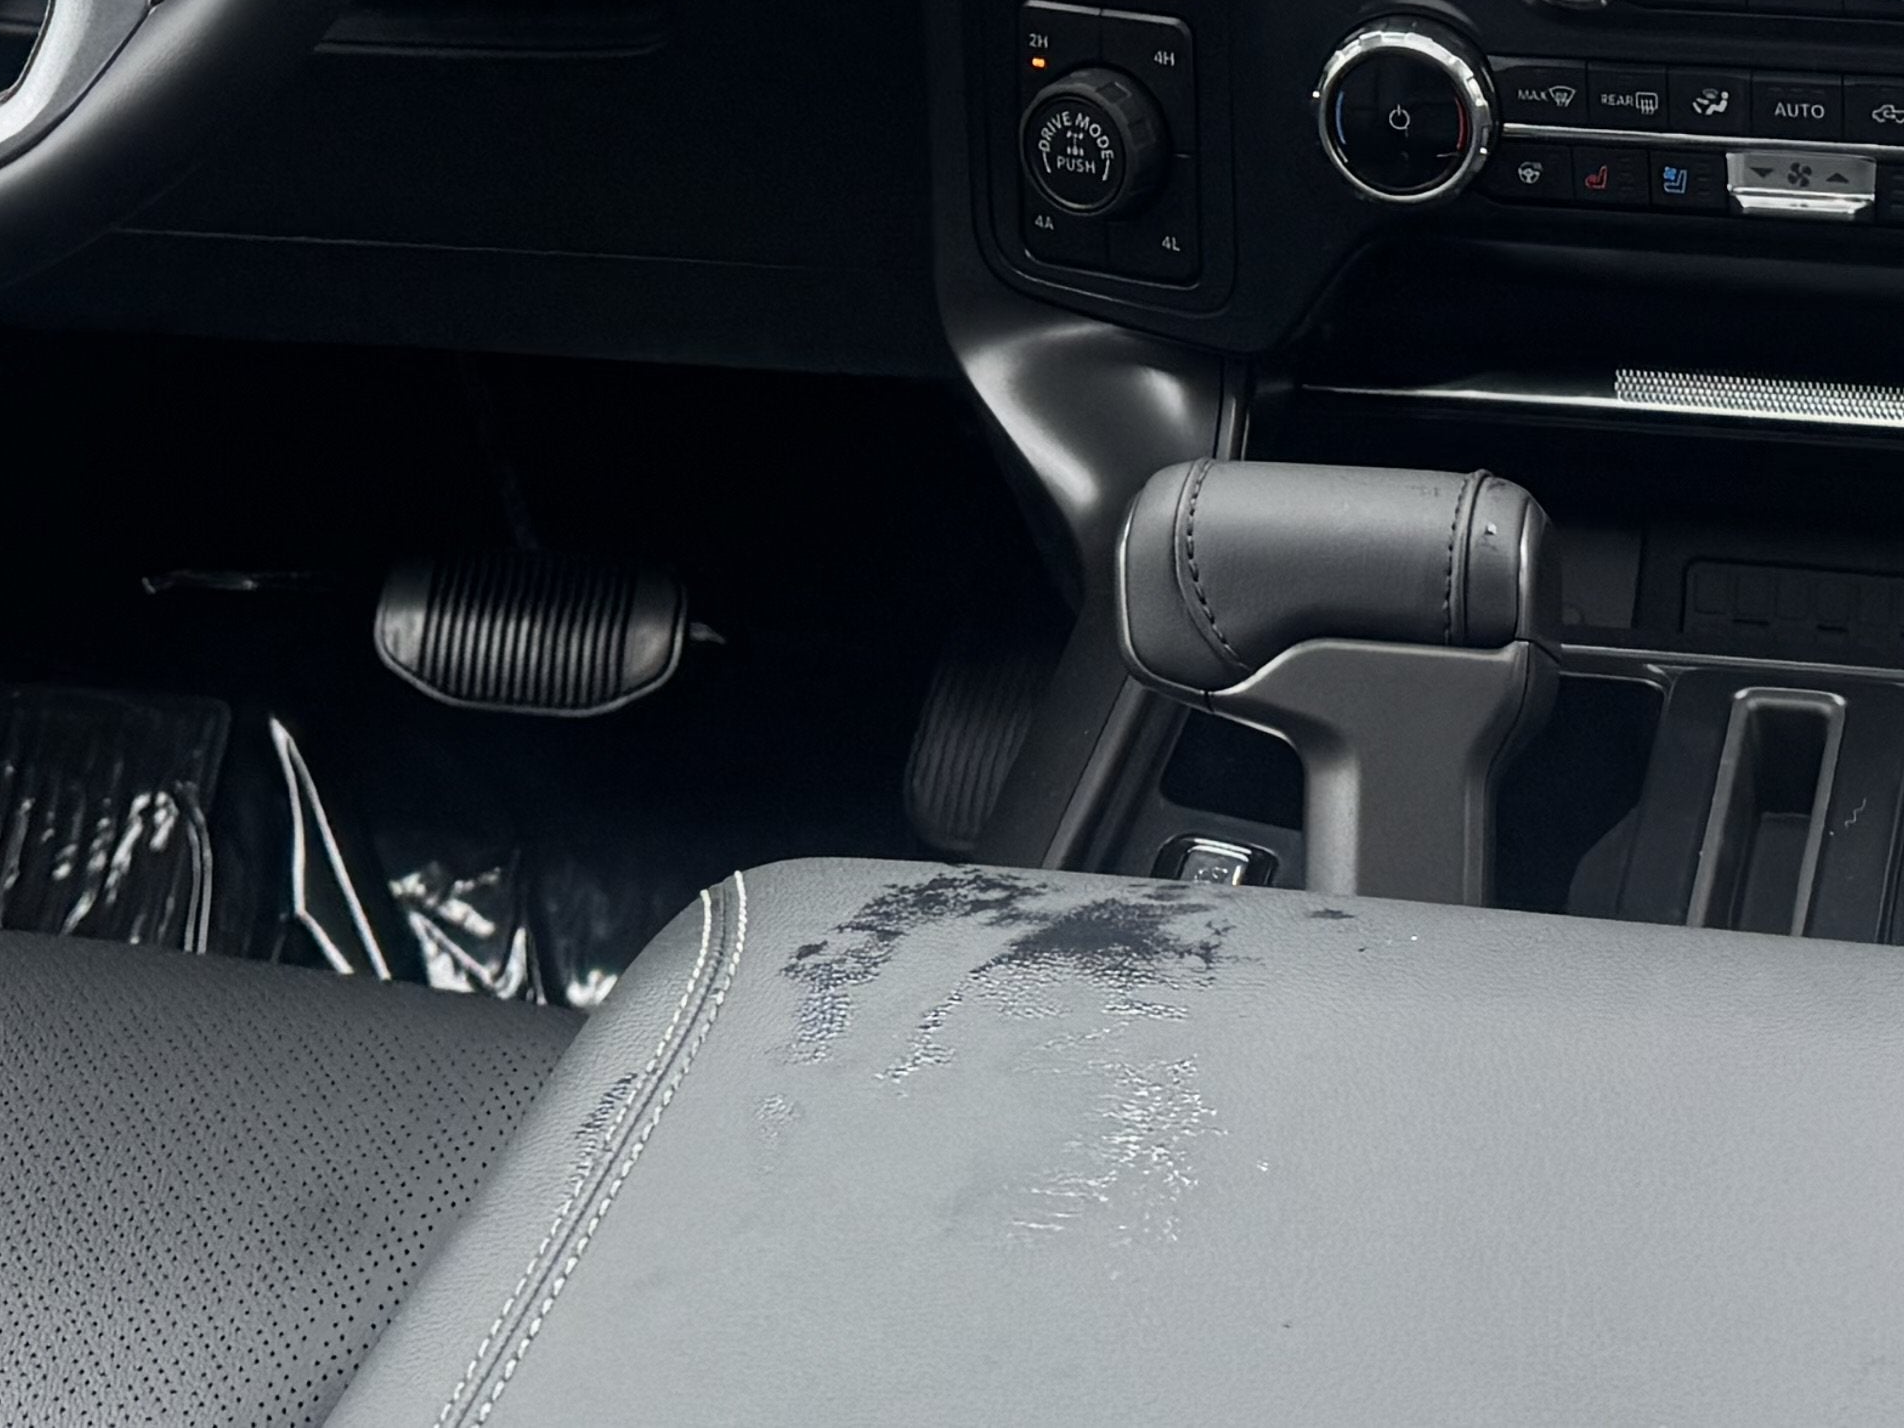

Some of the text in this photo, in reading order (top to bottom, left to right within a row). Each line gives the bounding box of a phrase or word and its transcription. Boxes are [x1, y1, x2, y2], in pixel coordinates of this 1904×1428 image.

[1029, 34, 1048, 48] 2H
[1154, 51, 1175, 66] 4H
[1517, 89, 1548, 103] MAX
[1601, 94, 1634, 108] REAR
[1774, 102, 1825, 119] AUTO
[1038, 110, 1114, 160] DRIVE MODE
[1056, 155, 1096, 174] PUSH
[1035, 215, 1054, 231] 4A
[1162, 236, 1181, 252] 4L
